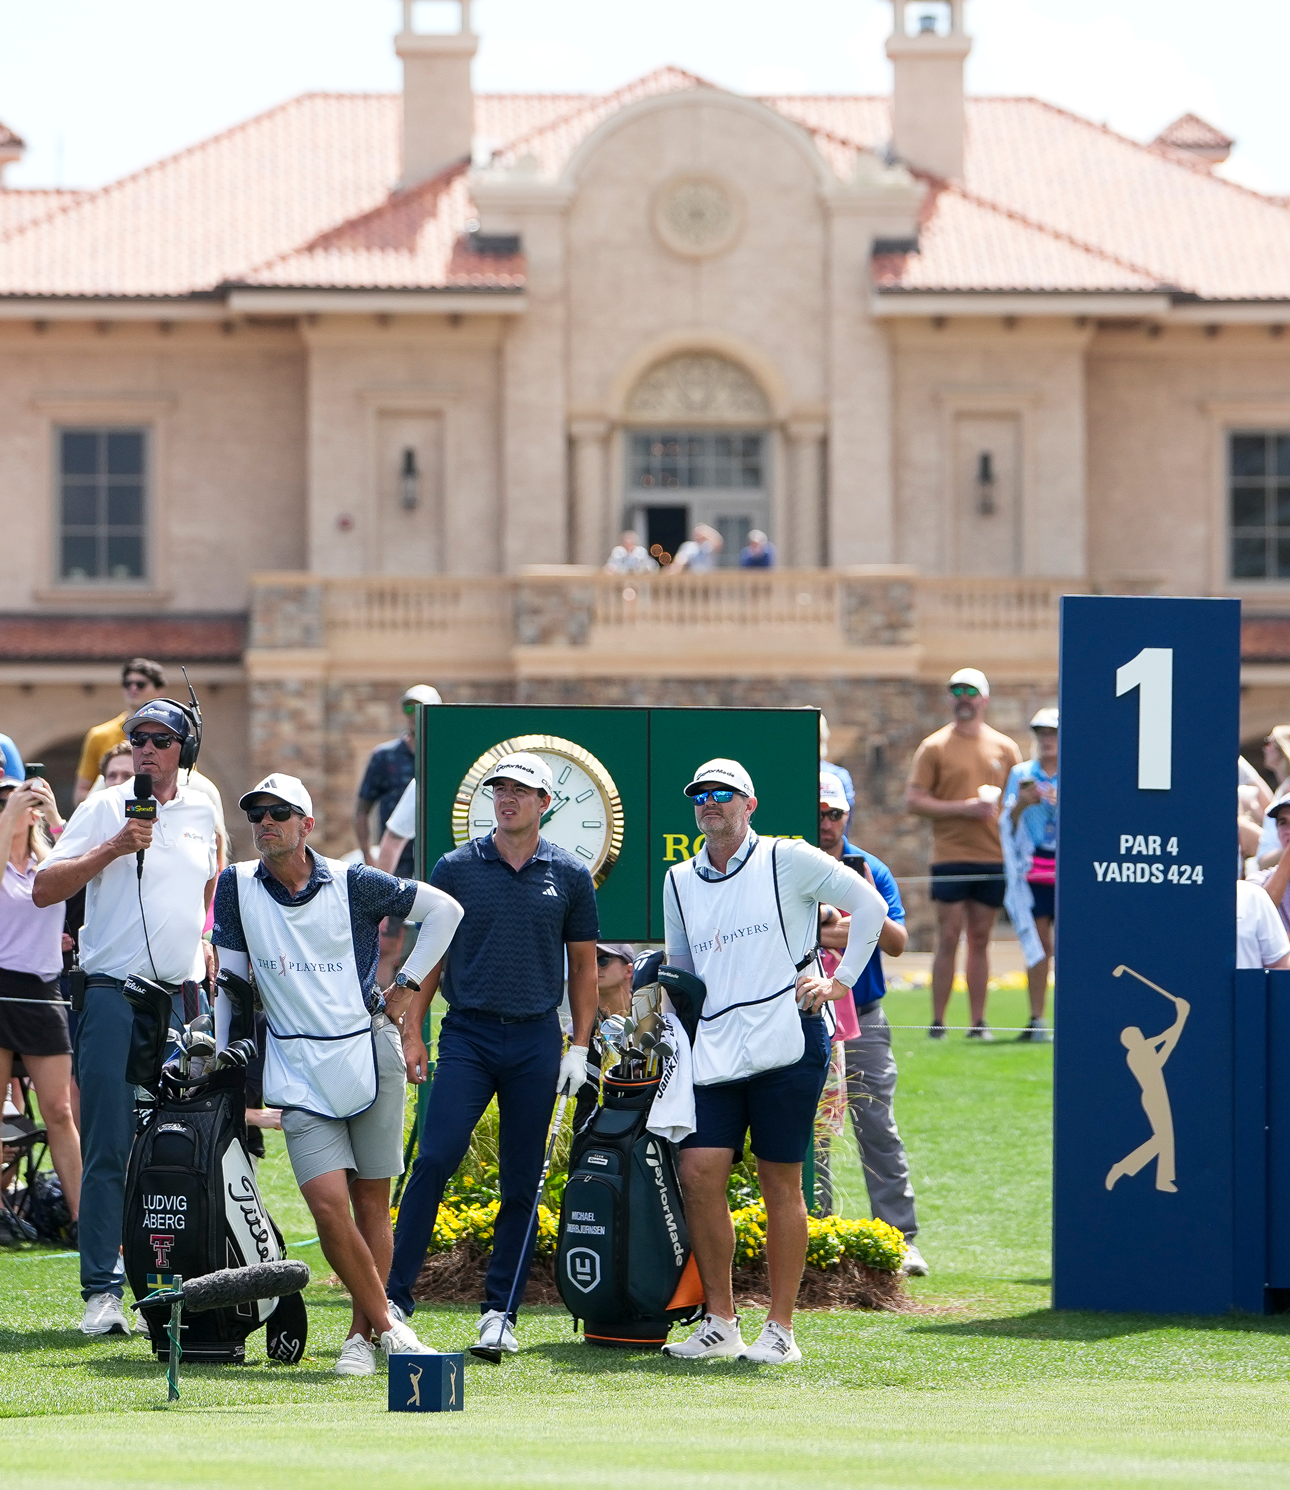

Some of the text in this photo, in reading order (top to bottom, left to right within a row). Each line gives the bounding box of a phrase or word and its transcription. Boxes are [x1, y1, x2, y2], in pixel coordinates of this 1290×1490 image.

[147, 707, 170, 716] Sports
[1115, 648, 1173, 790] 1
[496, 763, 535, 775] TaylorMade
[134, 804, 155, 812] Sports
[1119, 834, 1179, 857] PAR 4
[1093, 861, 1204, 885] YARDS 424
[257, 957, 343, 973] THE PLAYERS
[142, 1194, 187, 1211] LUDVIG
[645, 1141, 685, 1267] TaylorMade
[142, 1209, 186, 1230] ÅBERG
[228, 1175, 274, 1263] Title
